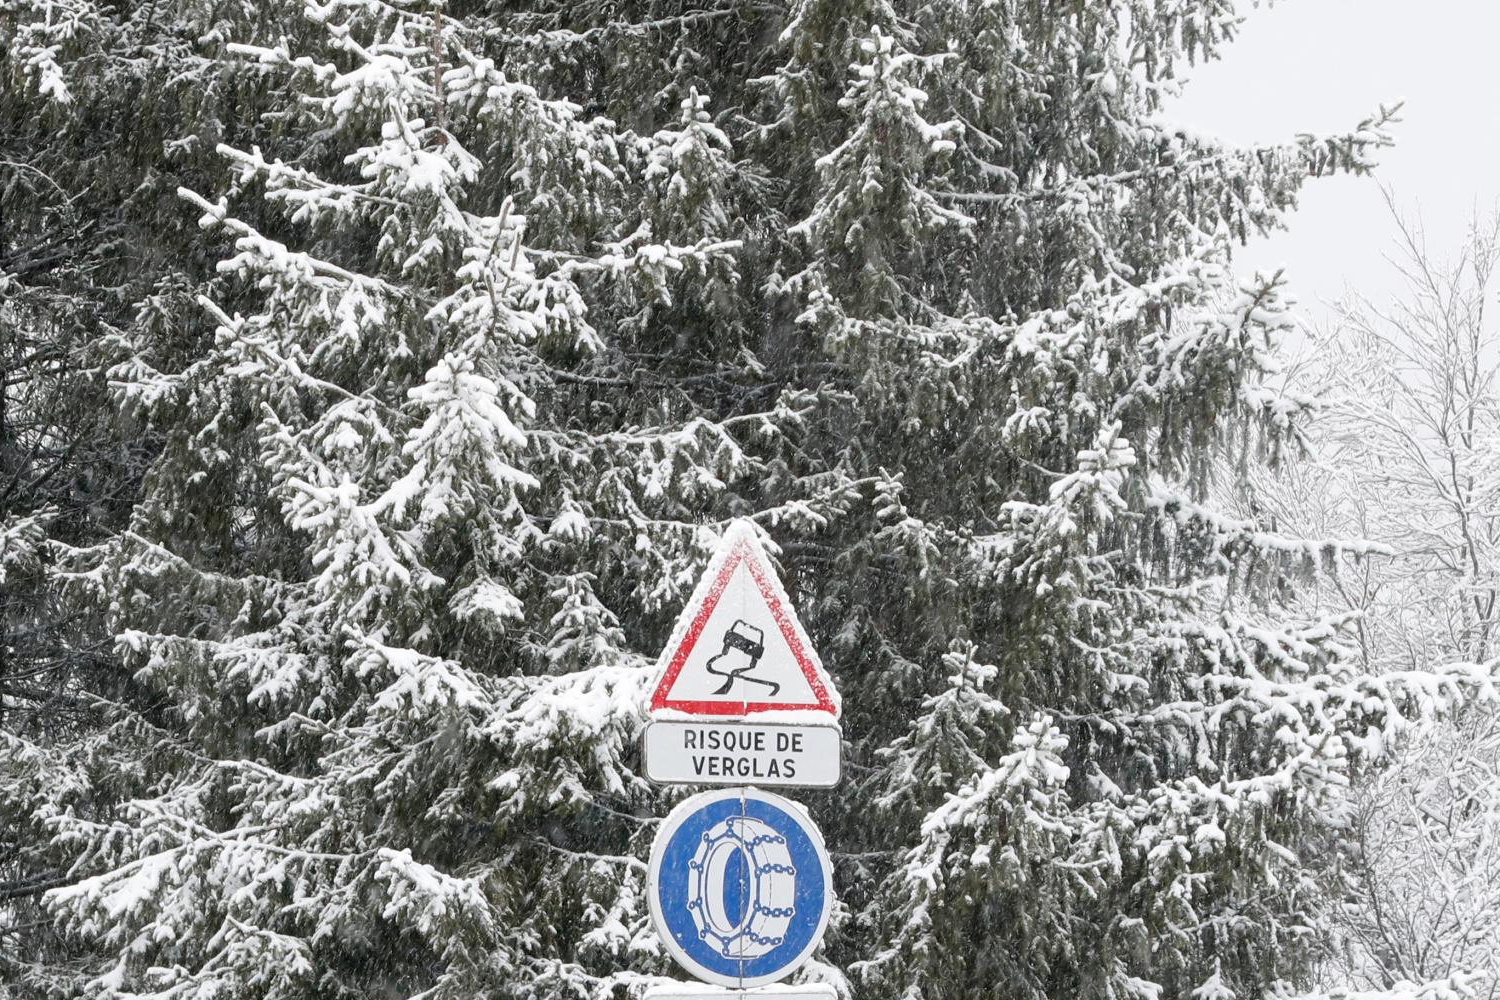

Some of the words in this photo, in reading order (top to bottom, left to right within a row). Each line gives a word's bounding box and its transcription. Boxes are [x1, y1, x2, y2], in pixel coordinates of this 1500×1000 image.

[684, 729, 765, 752] RISQUE
[777, 732, 803, 752] DE
[692, 756, 796, 778] VERGLAS
